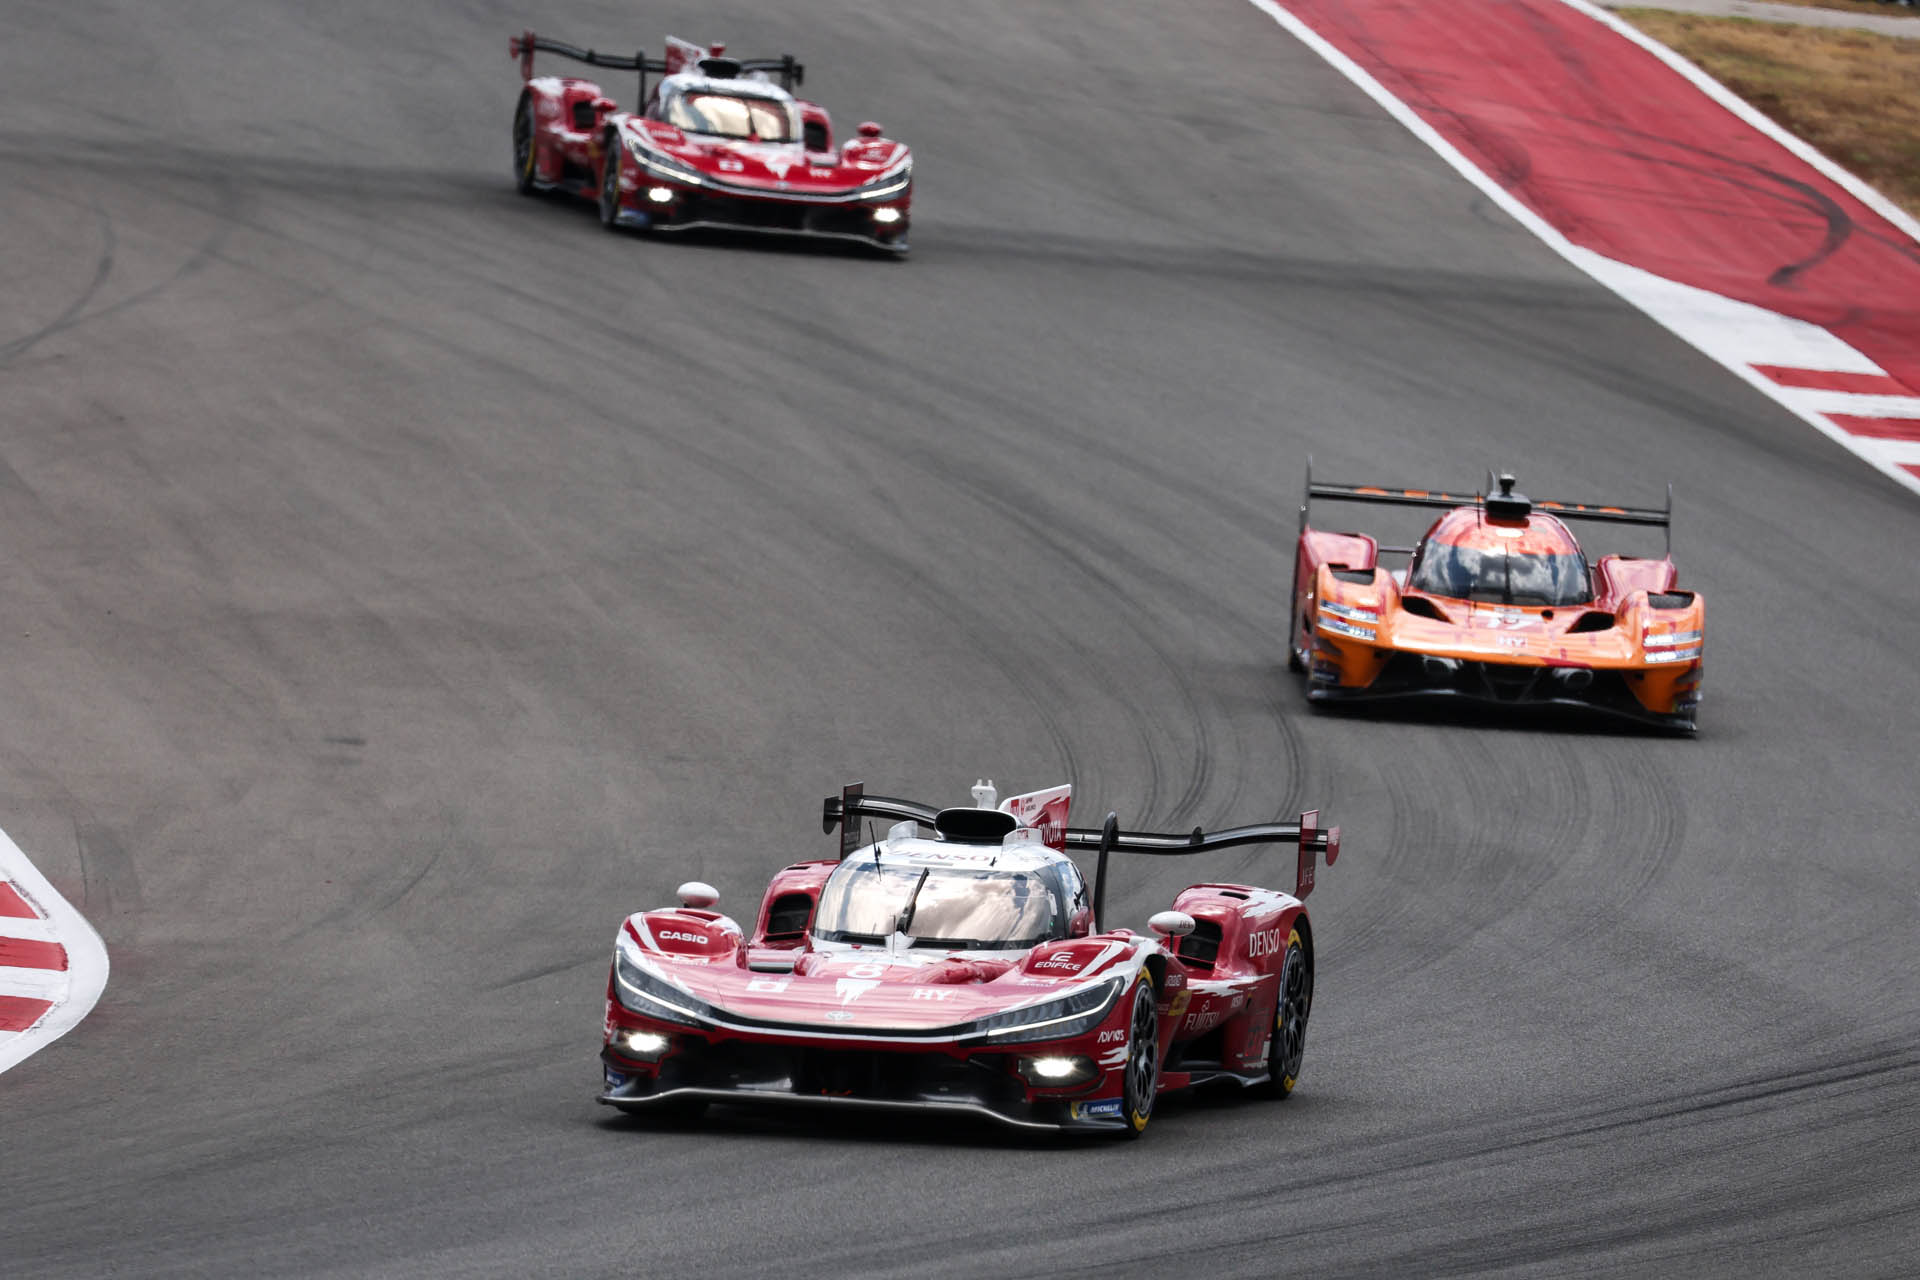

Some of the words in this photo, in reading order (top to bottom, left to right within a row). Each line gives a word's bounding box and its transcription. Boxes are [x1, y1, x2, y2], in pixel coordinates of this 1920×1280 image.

[659, 930, 709, 945] CASIO
[1249, 928, 1280, 957] DENSO
[846, 963, 884, 979] 8
[1034, 961, 1082, 971] EDIFICE
[912, 988, 954, 1001] HY
[1183, 1011, 1222, 1032] FUJITSU
[1090, 1103, 1121, 1114] MICHELIN
